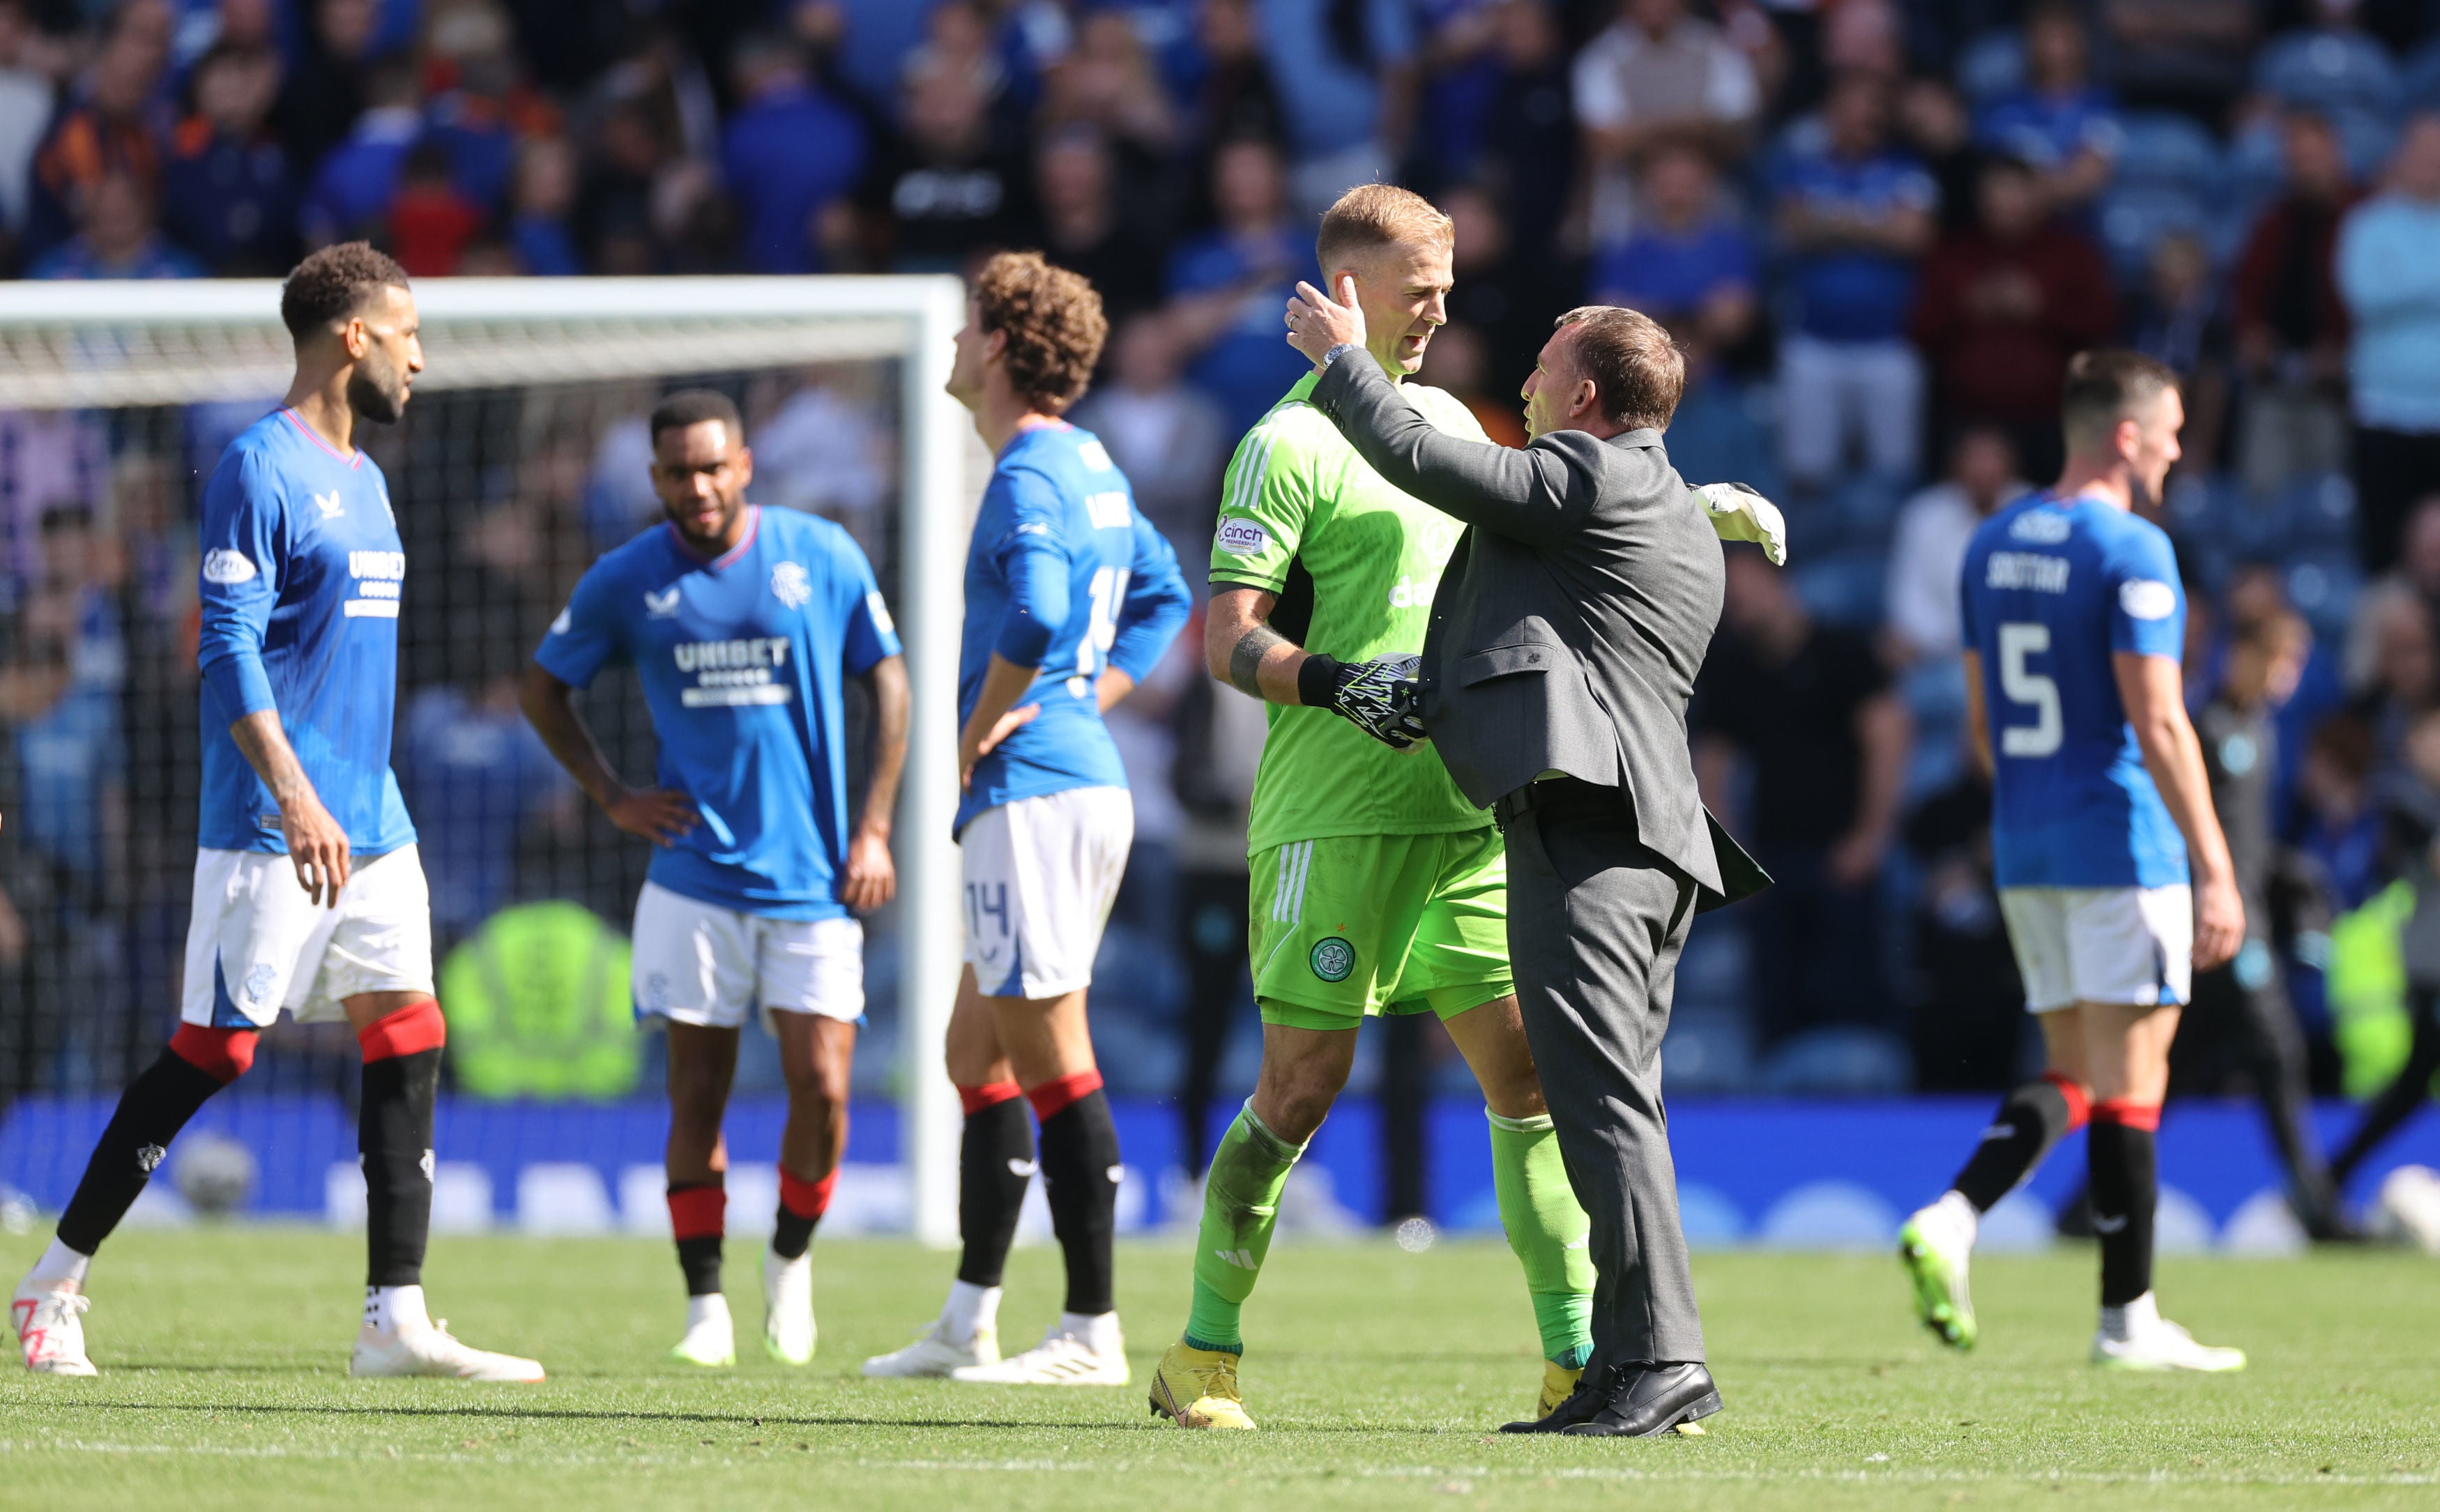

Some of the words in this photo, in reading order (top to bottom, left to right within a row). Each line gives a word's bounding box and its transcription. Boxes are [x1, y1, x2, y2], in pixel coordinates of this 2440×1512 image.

[1224, 522, 1263, 542] cinch
[1226, 539, 1256, 547] PREMIERSHIP
[673, 636, 791, 673] UNIBET
[1999, 623, 2064, 758] 5
[966, 881, 1009, 938] 14
